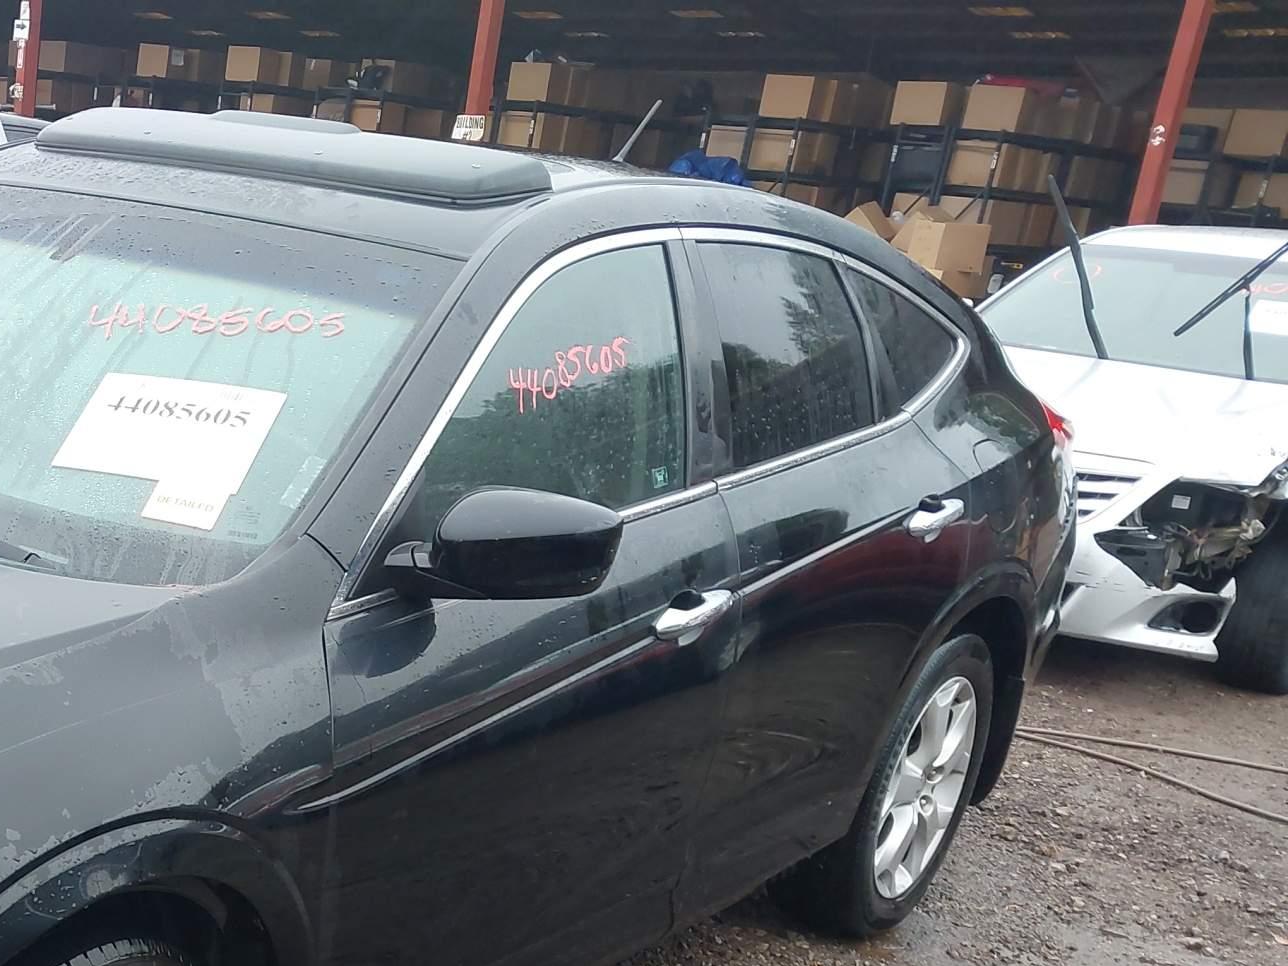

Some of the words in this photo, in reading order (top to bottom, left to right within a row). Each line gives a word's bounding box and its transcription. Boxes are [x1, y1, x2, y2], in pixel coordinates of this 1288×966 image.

[456, 116, 484, 129] BUILDING
[88, 304, 345, 340] 44085605
[507, 336, 632, 414] 44085605
[107, 395, 251, 428] 44085605
